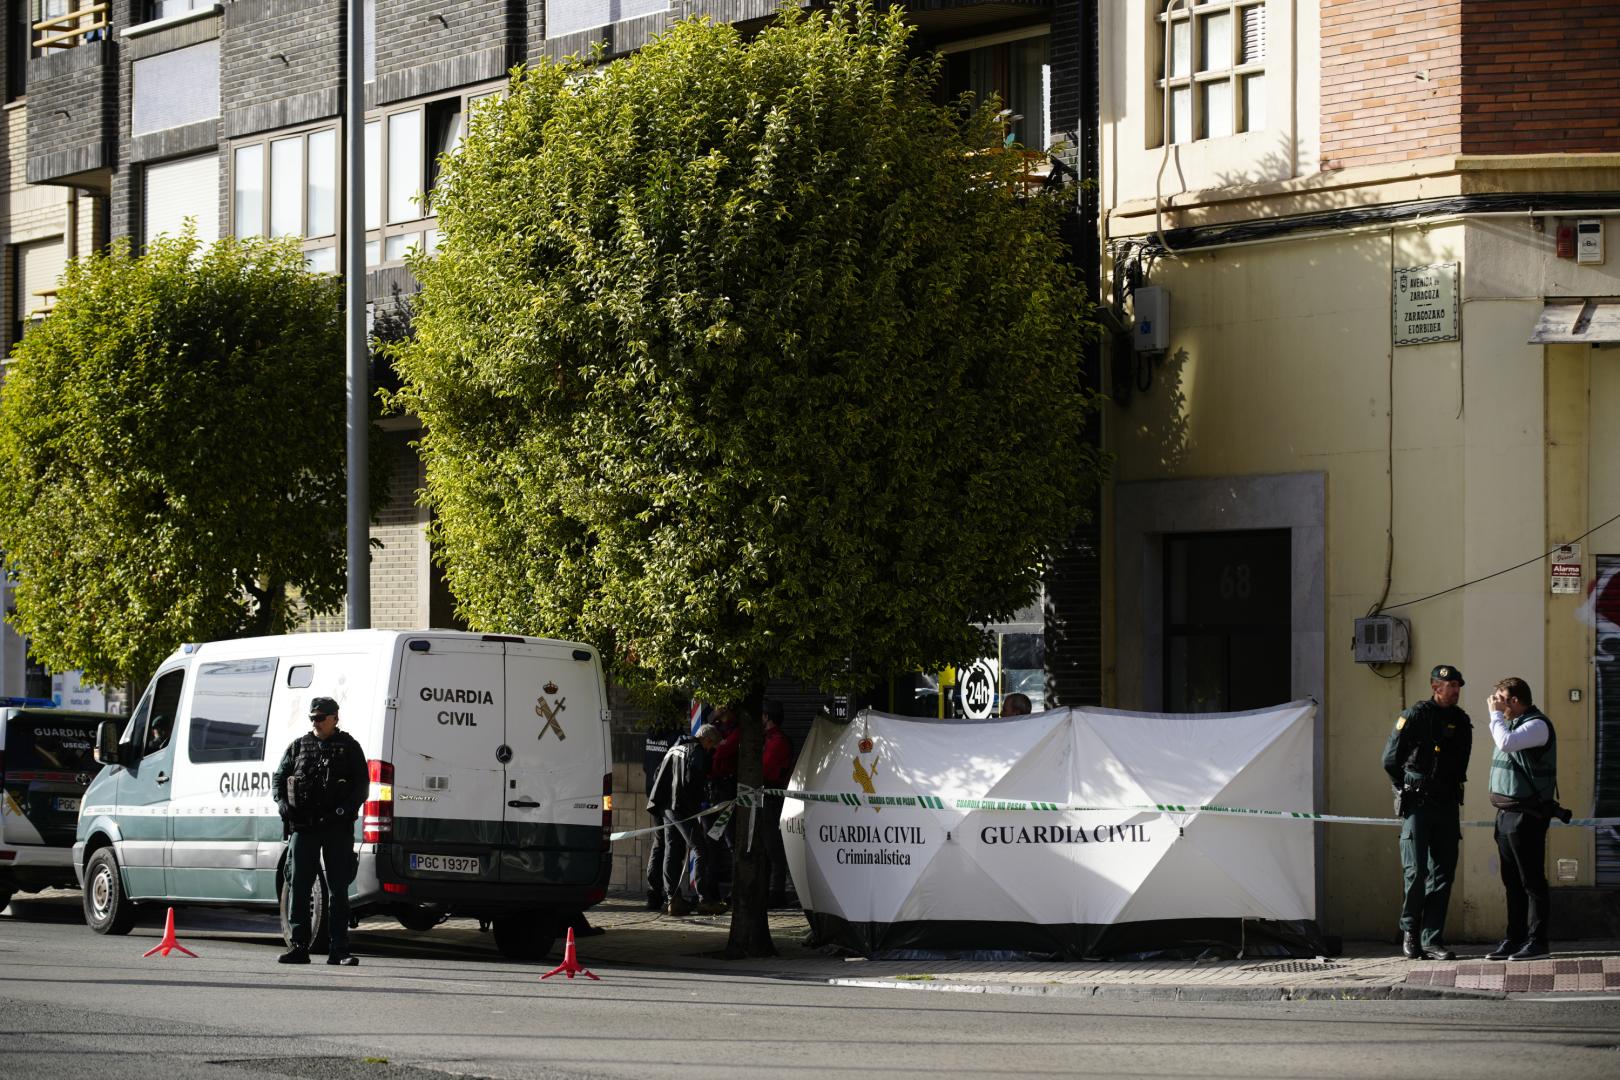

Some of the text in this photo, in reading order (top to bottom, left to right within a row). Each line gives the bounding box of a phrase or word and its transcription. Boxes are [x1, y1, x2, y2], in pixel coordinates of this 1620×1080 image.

[1410, 277, 1432, 288] AVENIDA
[1410, 289, 1440, 301] ZARAGOZA
[1404, 309, 1444, 322] ZARAGOZAKO
[1408, 323, 1441, 334] ETORBIDEA
[1219, 564, 1252, 600] 68
[420, 687, 494, 705] GUARDIA
[968, 679, 988, 705] 24h
[437, 711, 477, 727] CIVIL
[33, 727, 86, 738] GUARDIA
[58, 799, 75, 809] PGC
[956, 799, 1026, 811] GUARDIA CIVIL NO PASAR
[819, 825, 926, 845] GUARDIA CIVIL
[980, 824, 1151, 845] GUARDIA CIVIL
[417, 856, 439, 869] PGC
[836, 848, 911, 866] Criminalística
